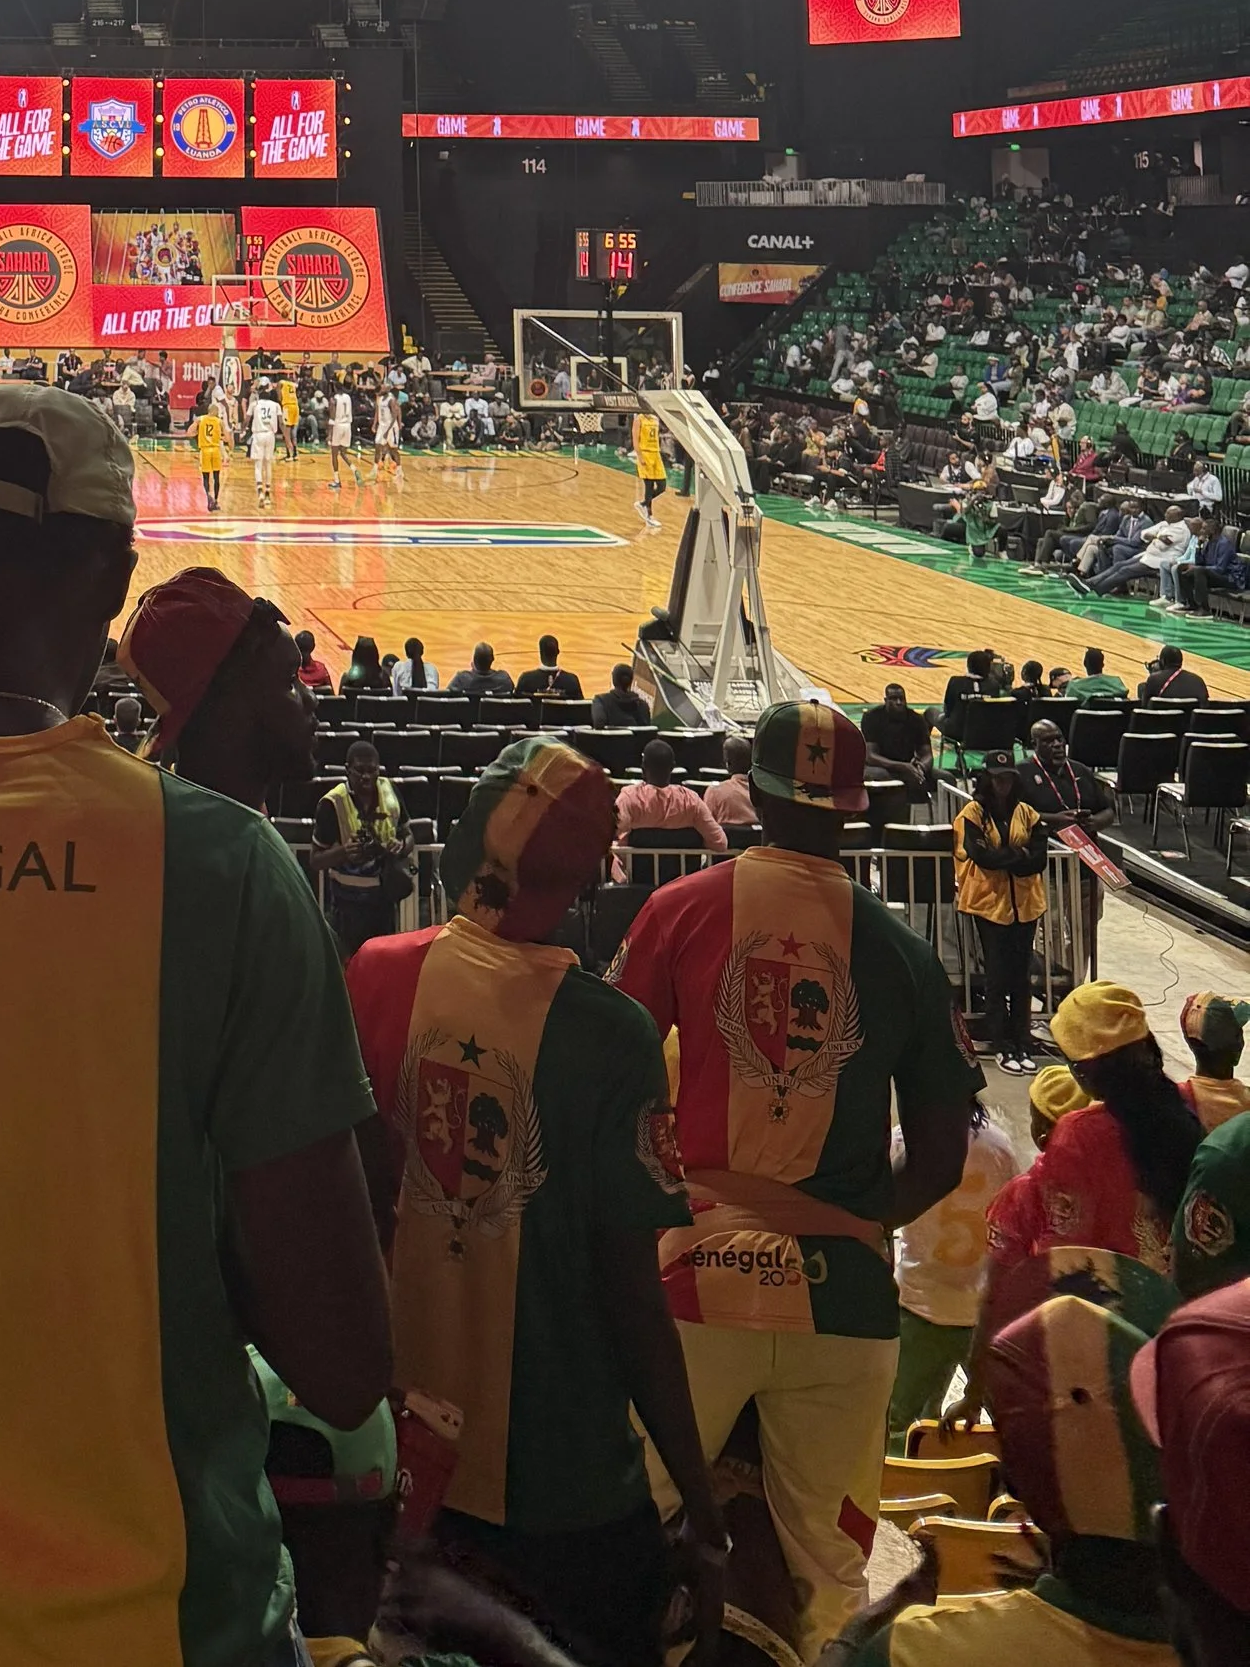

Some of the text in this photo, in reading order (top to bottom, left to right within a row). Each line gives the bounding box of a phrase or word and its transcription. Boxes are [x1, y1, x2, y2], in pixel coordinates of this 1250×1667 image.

[22, 108, 53, 134] FOR
[178, 98, 199, 117] PETRO
[1002, 87, 1194, 130] GAME GAME GAME
[270, 110, 326, 140] ALL FOR
[437, 116, 746, 139] GAME GAME GAME
[14, 131, 57, 160] GAME
[185, 146, 223, 160] LUANDA
[261, 133, 330, 166] THE GAME
[522, 157, 548, 174] 114
[1134, 150, 1150, 170] 115
[20, 227, 54, 244] AFRICA
[53, 242, 75, 275] LEAGUE
[264, 229, 367, 278] BASKETBALL AFRICA LEAGUE
[605, 232, 636, 248] 6 55
[747, 234, 814, 250] CANAL+
[285, 253, 342, 275] SAHARA
[610, 251, 633, 279] 14
[719, 277, 792, 296] CONFERENCE SAHARA
[15, 290, 69, 321] CONFERENCE
[310, 293, 363, 324] CONFERENCE
[101, 311, 128, 335] ALL
[131, 308, 162, 333] FOR
[165, 306, 193, 330] THE
[762, 1074, 780, 1086] UN
[685, 1244, 783, 1274] énégal
